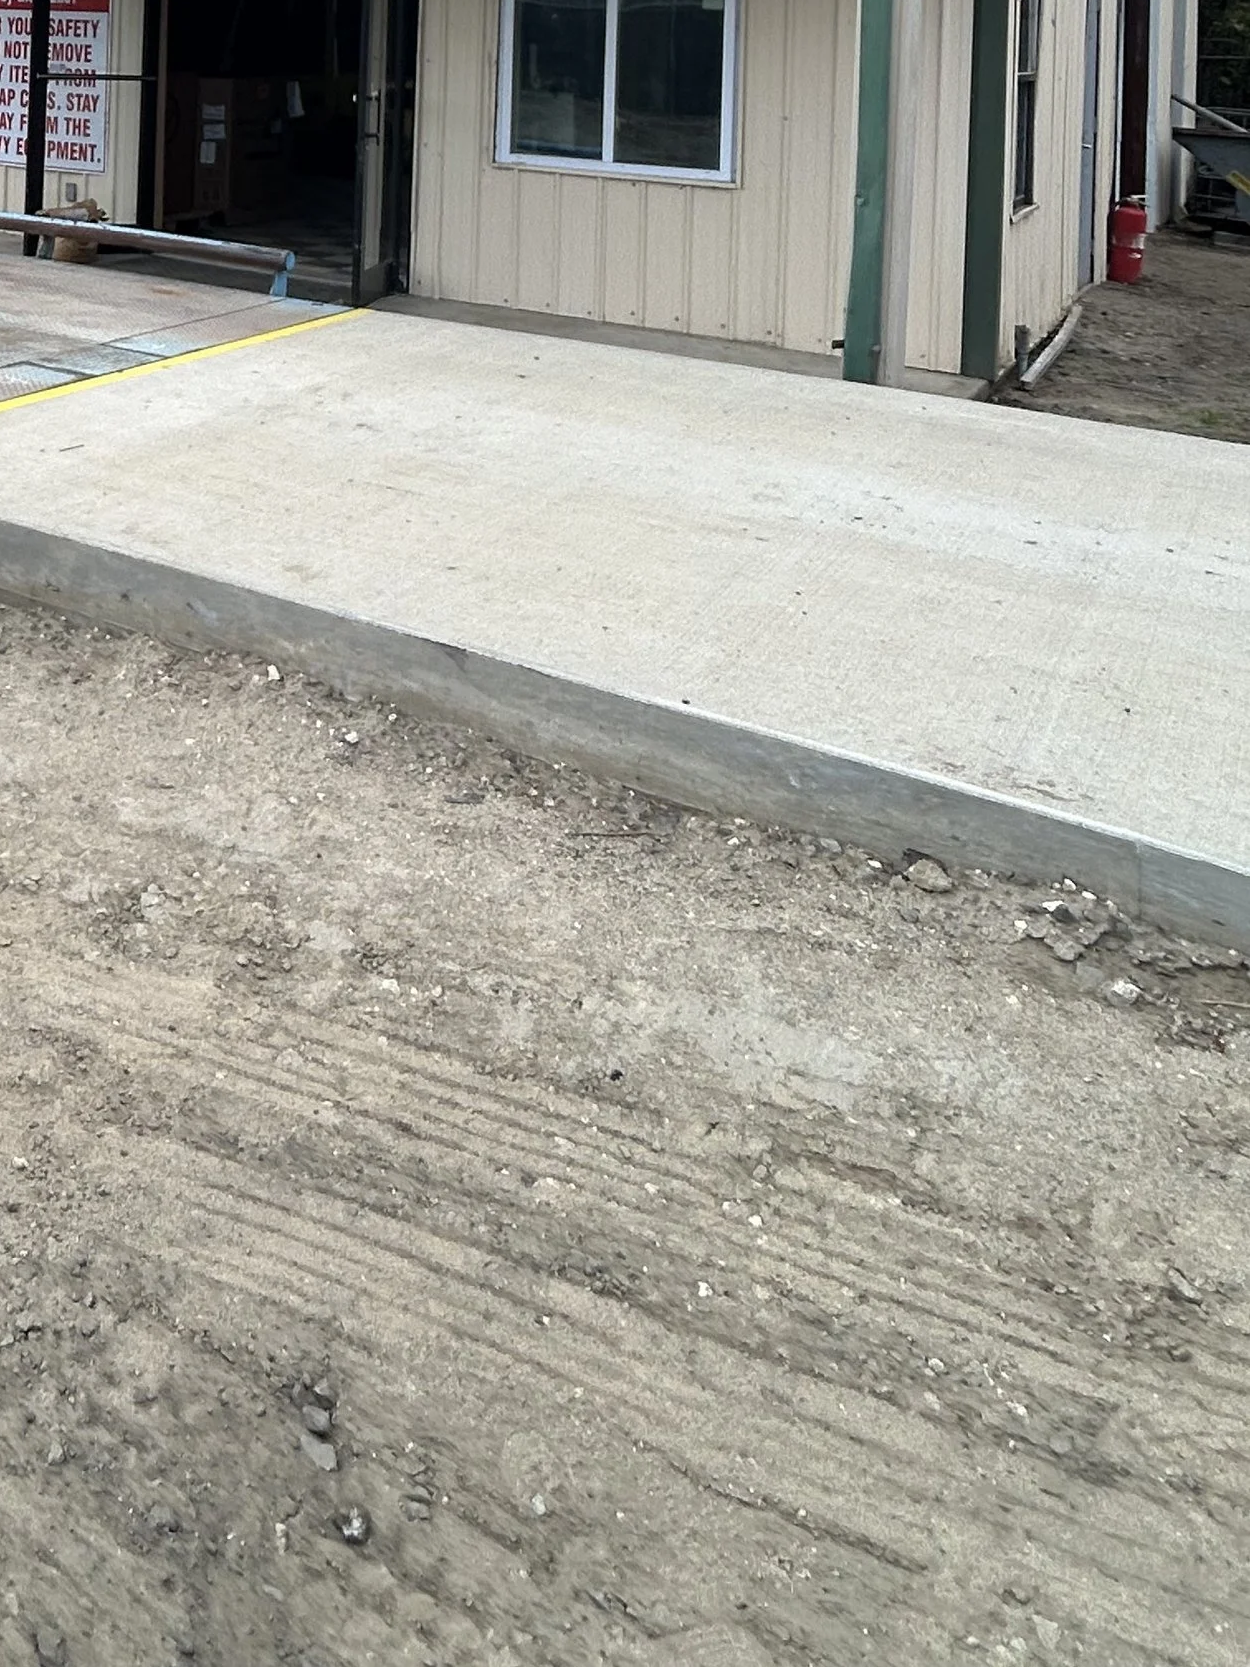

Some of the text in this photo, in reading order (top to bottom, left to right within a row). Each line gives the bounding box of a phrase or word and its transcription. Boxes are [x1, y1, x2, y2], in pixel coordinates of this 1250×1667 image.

[8, 16, 33, 36] YOU
[48, 18, 100, 39] SAFETY
[4, 40, 30, 60] NOT
[48, 43, 93, 63] MOVE
[20, 89, 61, 110] CS.
[66, 92, 100, 113] STAY
[20, 114, 59, 135] FM
[63, 116, 91, 137] THE
